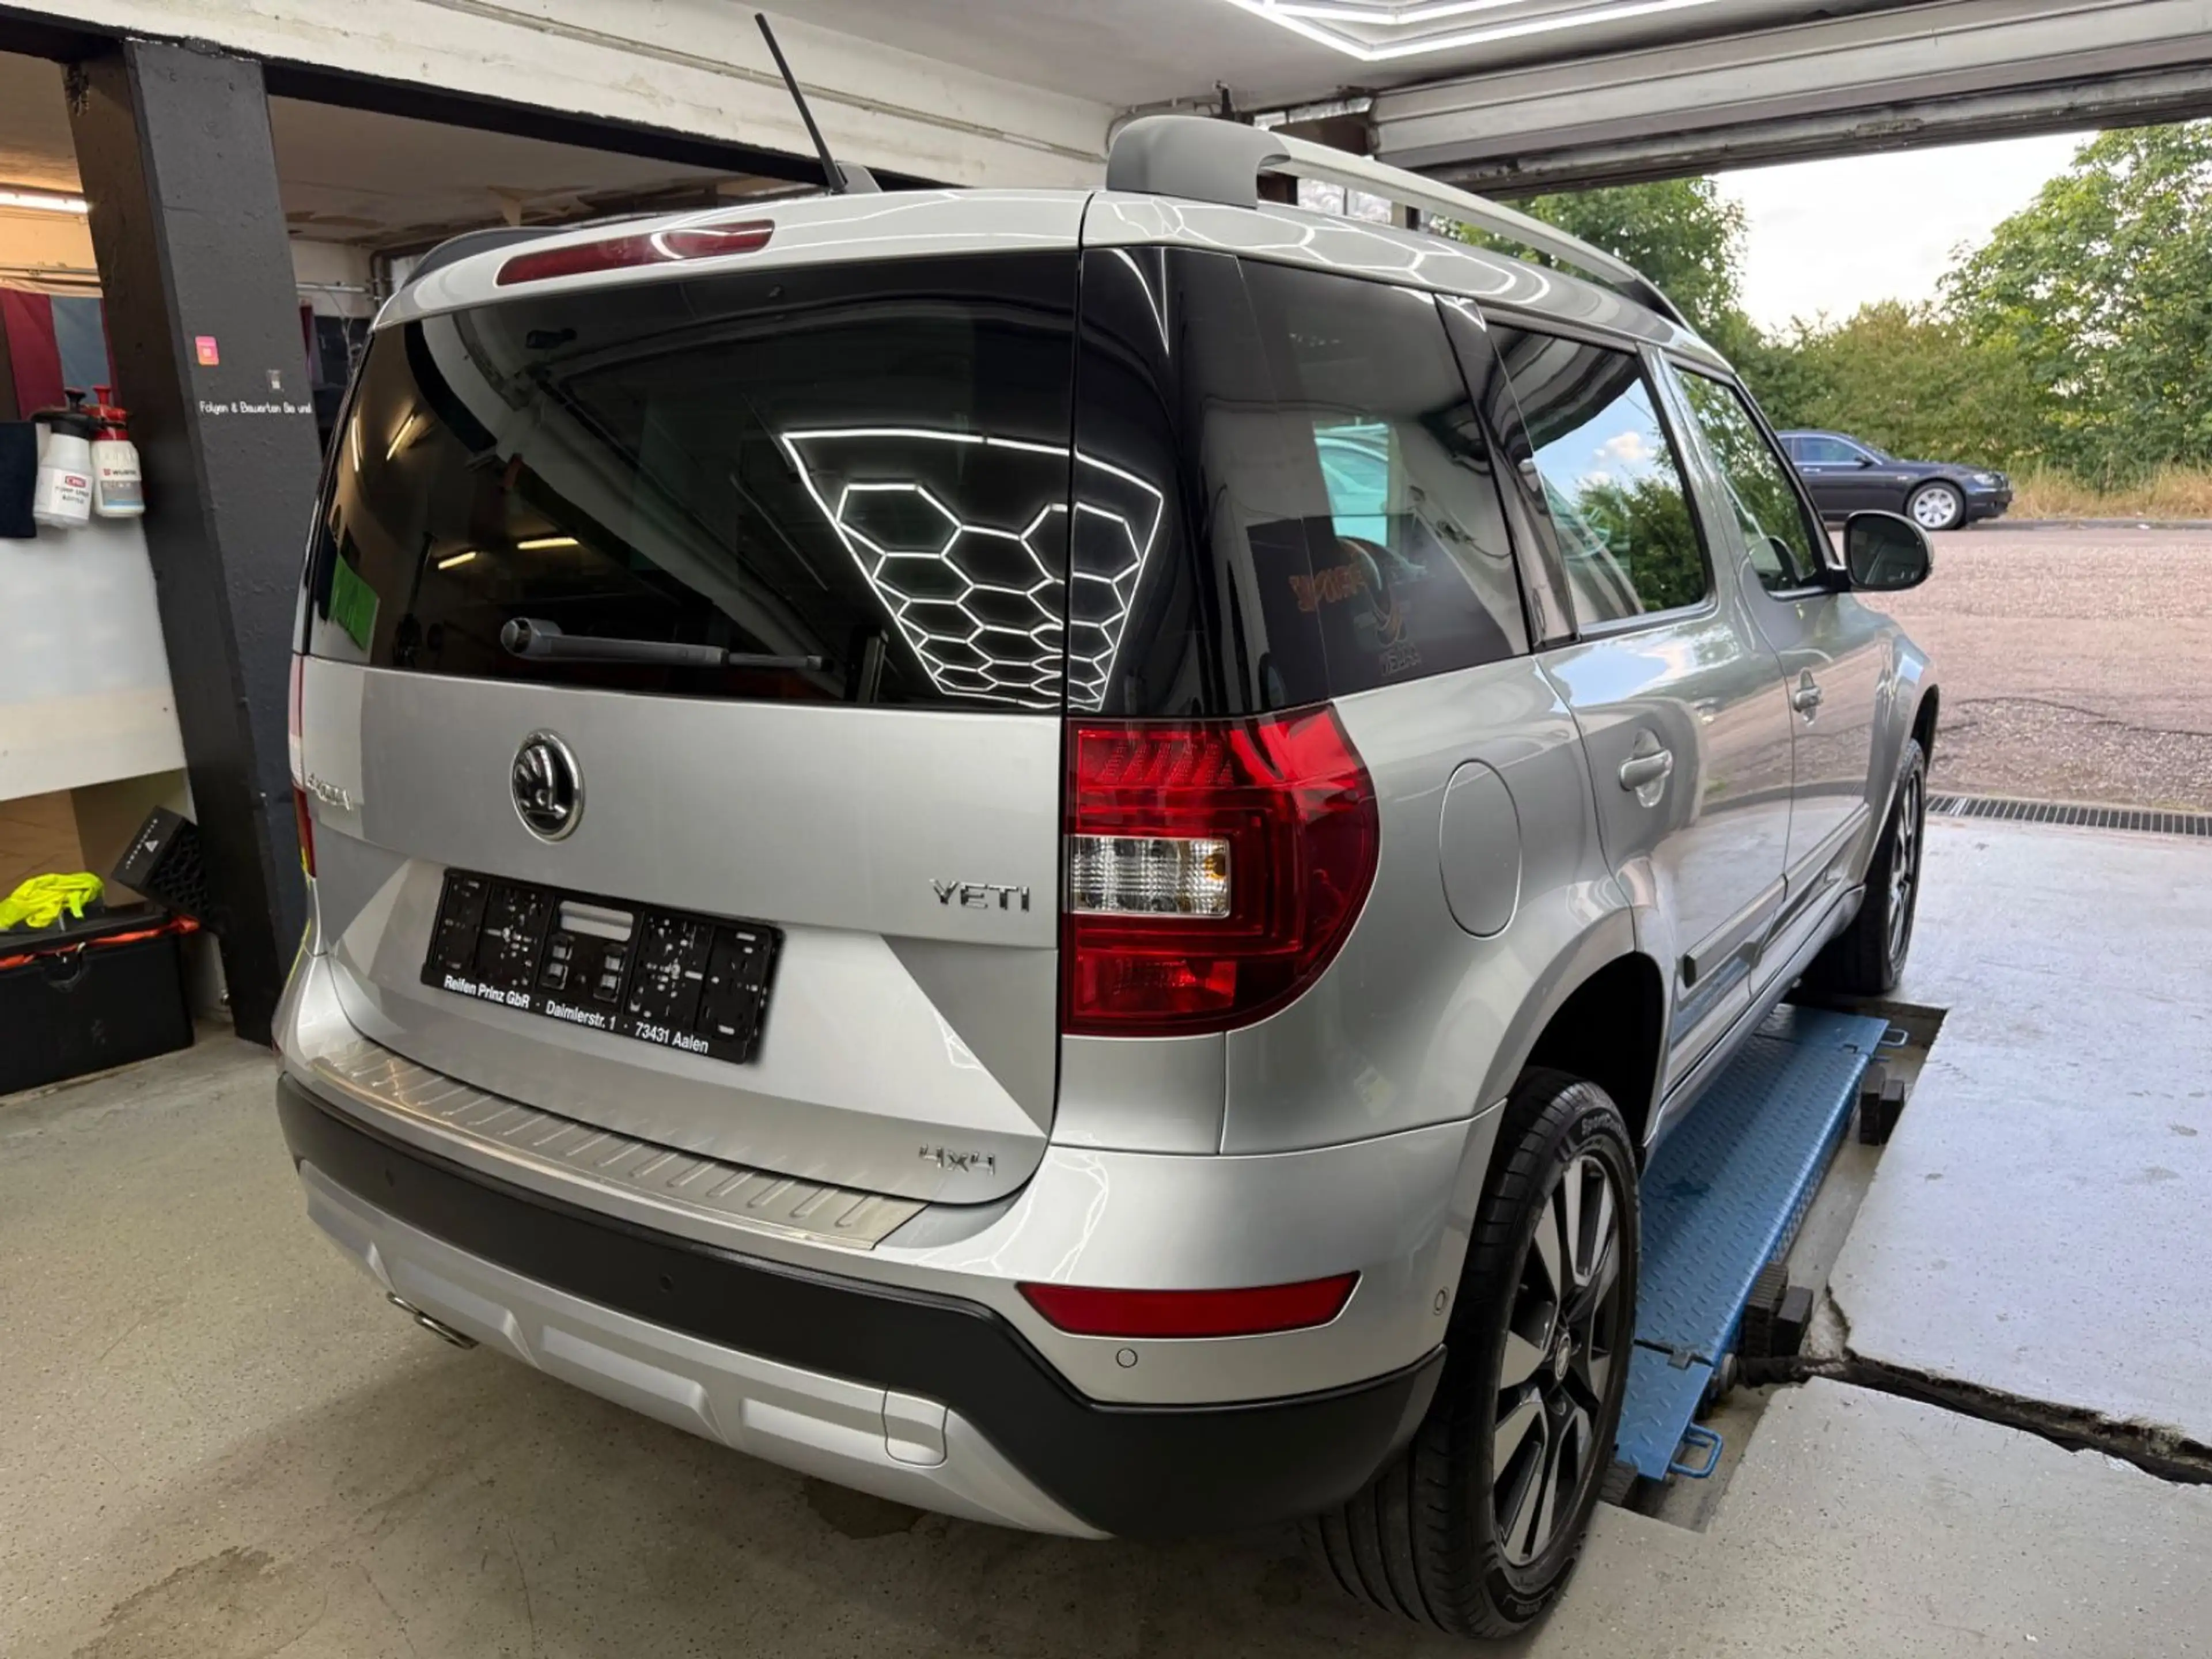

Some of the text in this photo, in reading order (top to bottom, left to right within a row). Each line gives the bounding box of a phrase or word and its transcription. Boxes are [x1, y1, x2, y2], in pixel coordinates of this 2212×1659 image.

[929, 878, 1030, 912] YETI
[444, 974, 709, 1054] Reifen Prinz GbR Daimlerstr. 1 73431 Aalen
